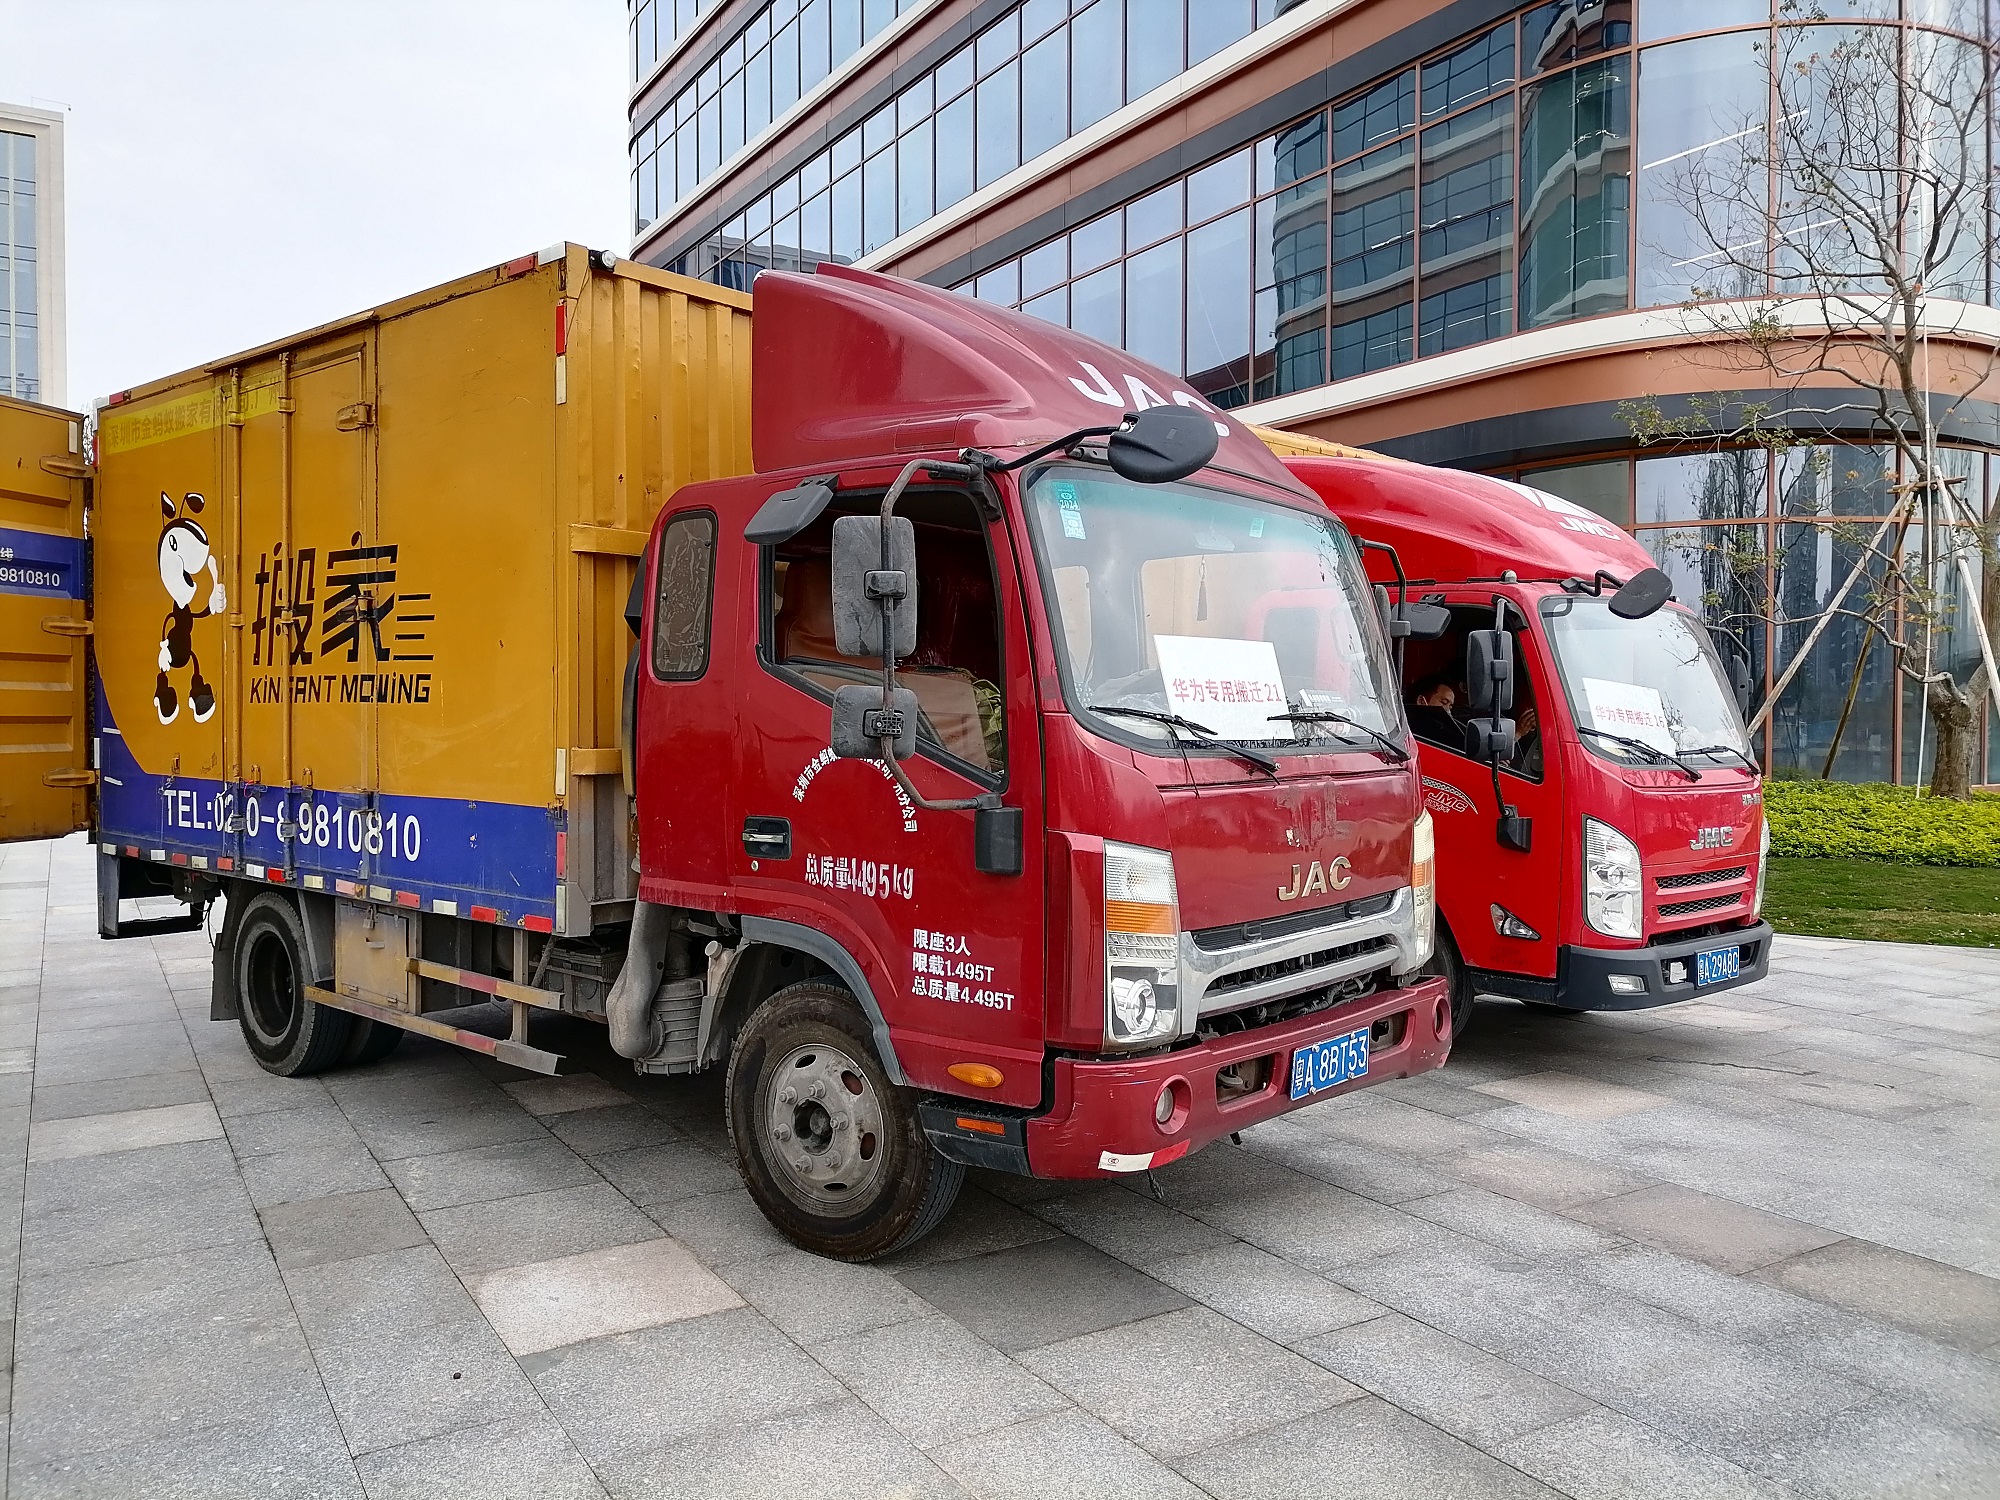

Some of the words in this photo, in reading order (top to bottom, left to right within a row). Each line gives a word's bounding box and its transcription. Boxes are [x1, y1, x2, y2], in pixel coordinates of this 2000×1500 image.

[1557, 515, 1621, 541] JMC
[0, 567, 60, 587] 9810810
[1428, 791, 1469, 813] JMC
[1689, 826, 1734, 851] JMC
[1277, 856, 1352, 901] JAC
[913, 928, 972, 957] 限座3人
[912, 951, 995, 983] 限载1.495T
[911, 975, 1015, 1011] 总质量4.495T
